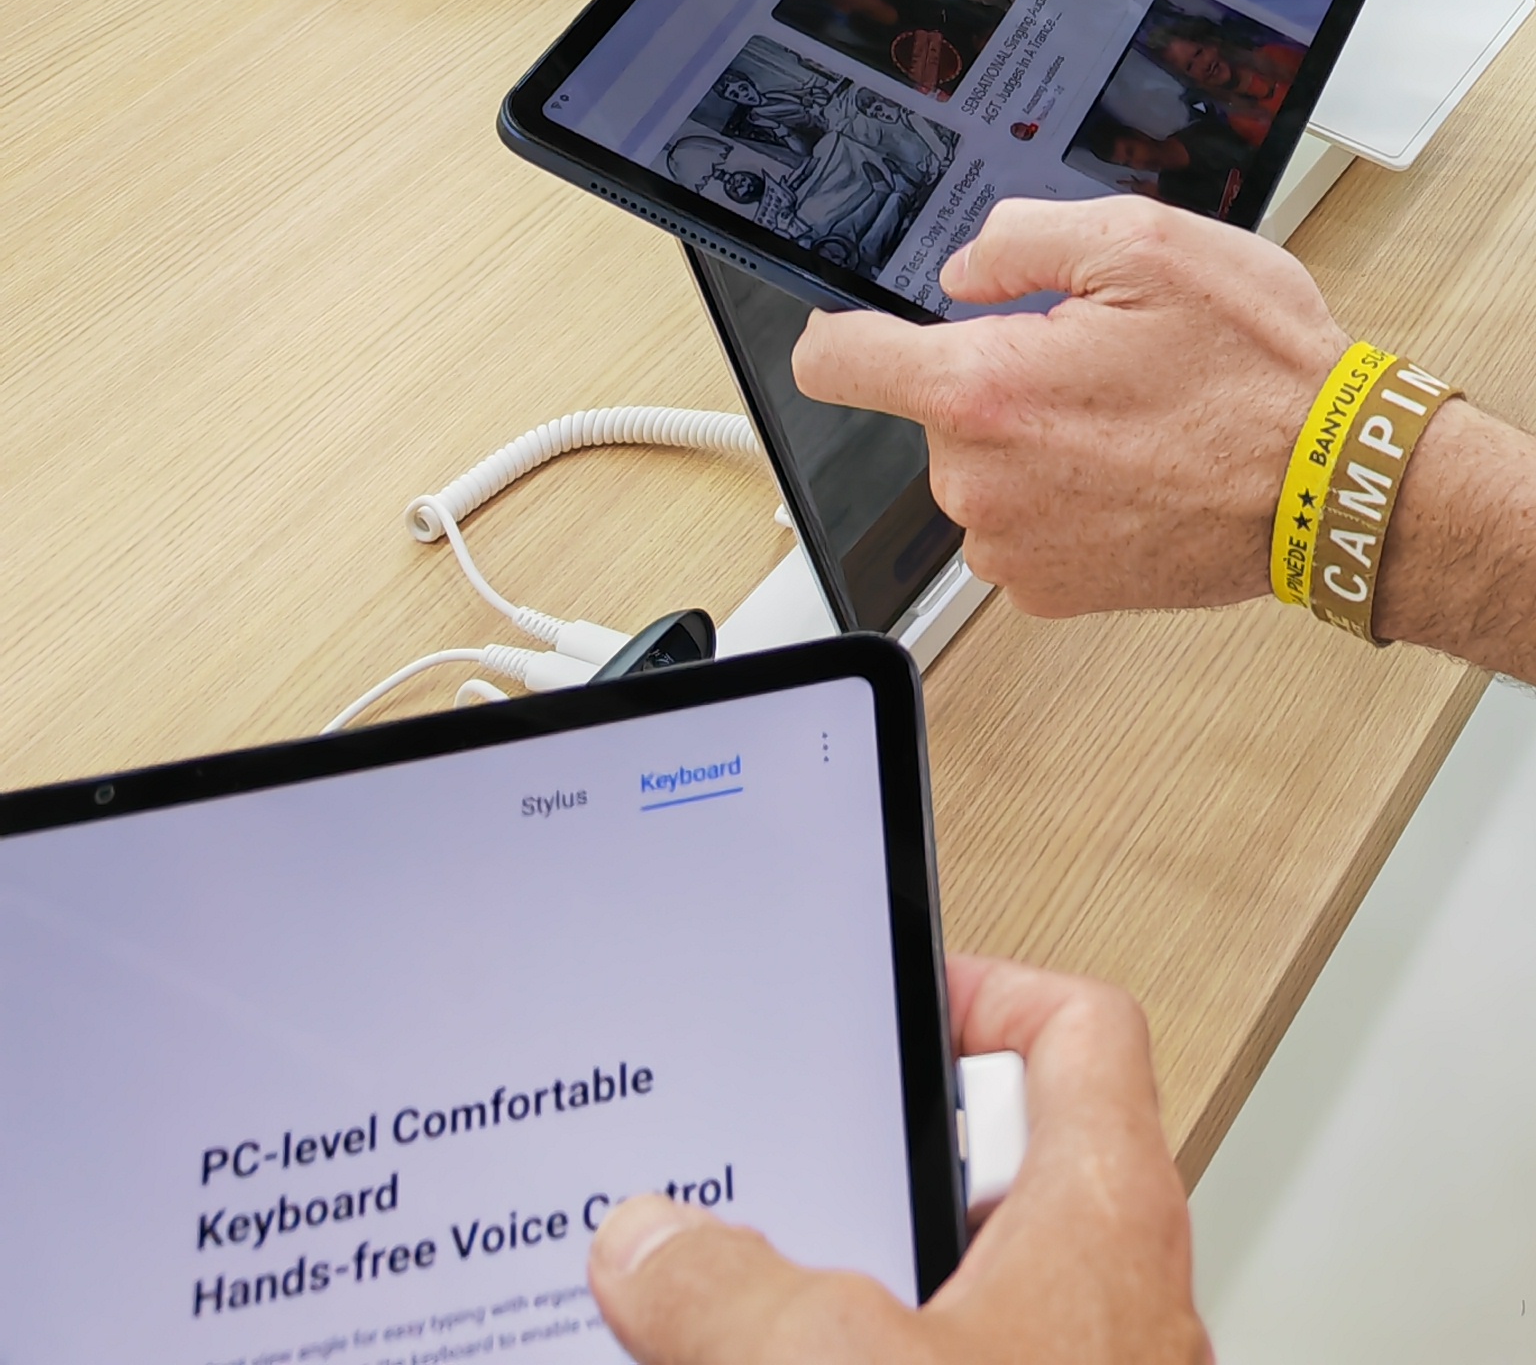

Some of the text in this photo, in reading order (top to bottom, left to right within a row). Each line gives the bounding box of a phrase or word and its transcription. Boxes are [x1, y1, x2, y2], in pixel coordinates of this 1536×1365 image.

[994, 65, 1028, 106] Judges
[953, 155, 988, 197] People
[961, 180, 999, 227] Vintage
[1309, 369, 1369, 468] BANYULS
[521, 754, 742, 819] Stylus Keyboard
[201, 1062, 654, 1185] PC-level Comfortable
[192, 1164, 733, 1317] Hands-free Voice Ctrol
[197, 1173, 398, 1251] Keyboard
